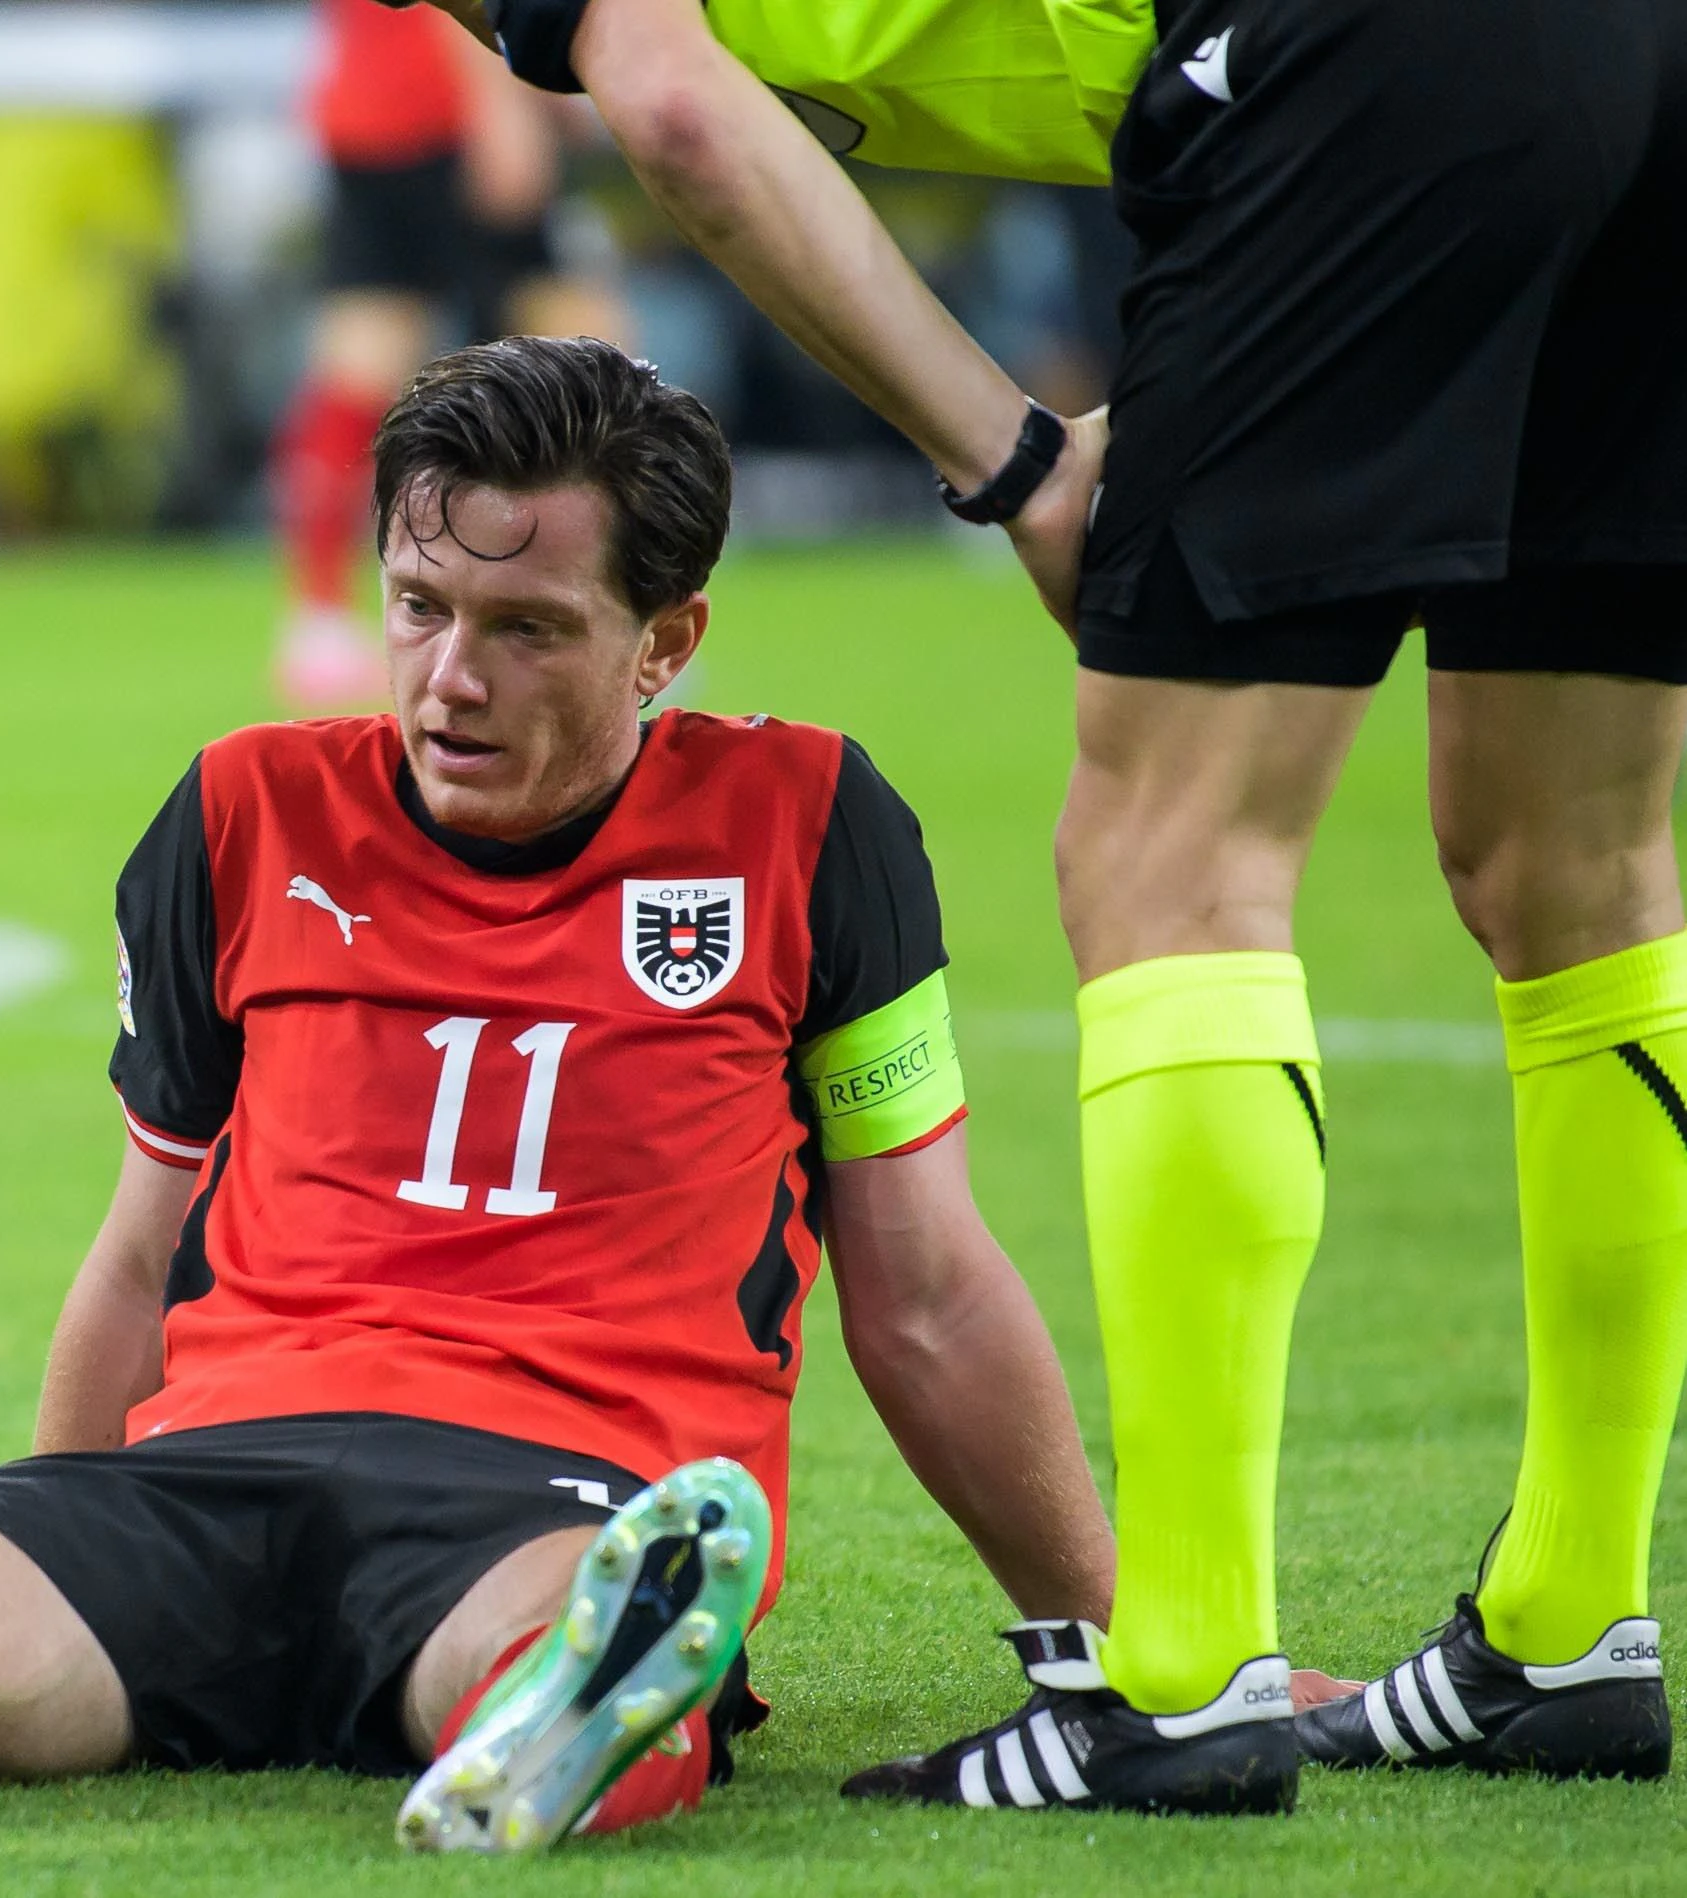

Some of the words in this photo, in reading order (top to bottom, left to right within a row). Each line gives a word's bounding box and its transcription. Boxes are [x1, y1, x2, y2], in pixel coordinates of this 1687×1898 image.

[659, 888, 708, 900] ÖFB
[828, 1040, 930, 1107] RESPECT
[396, 1016, 578, 1216] 11
